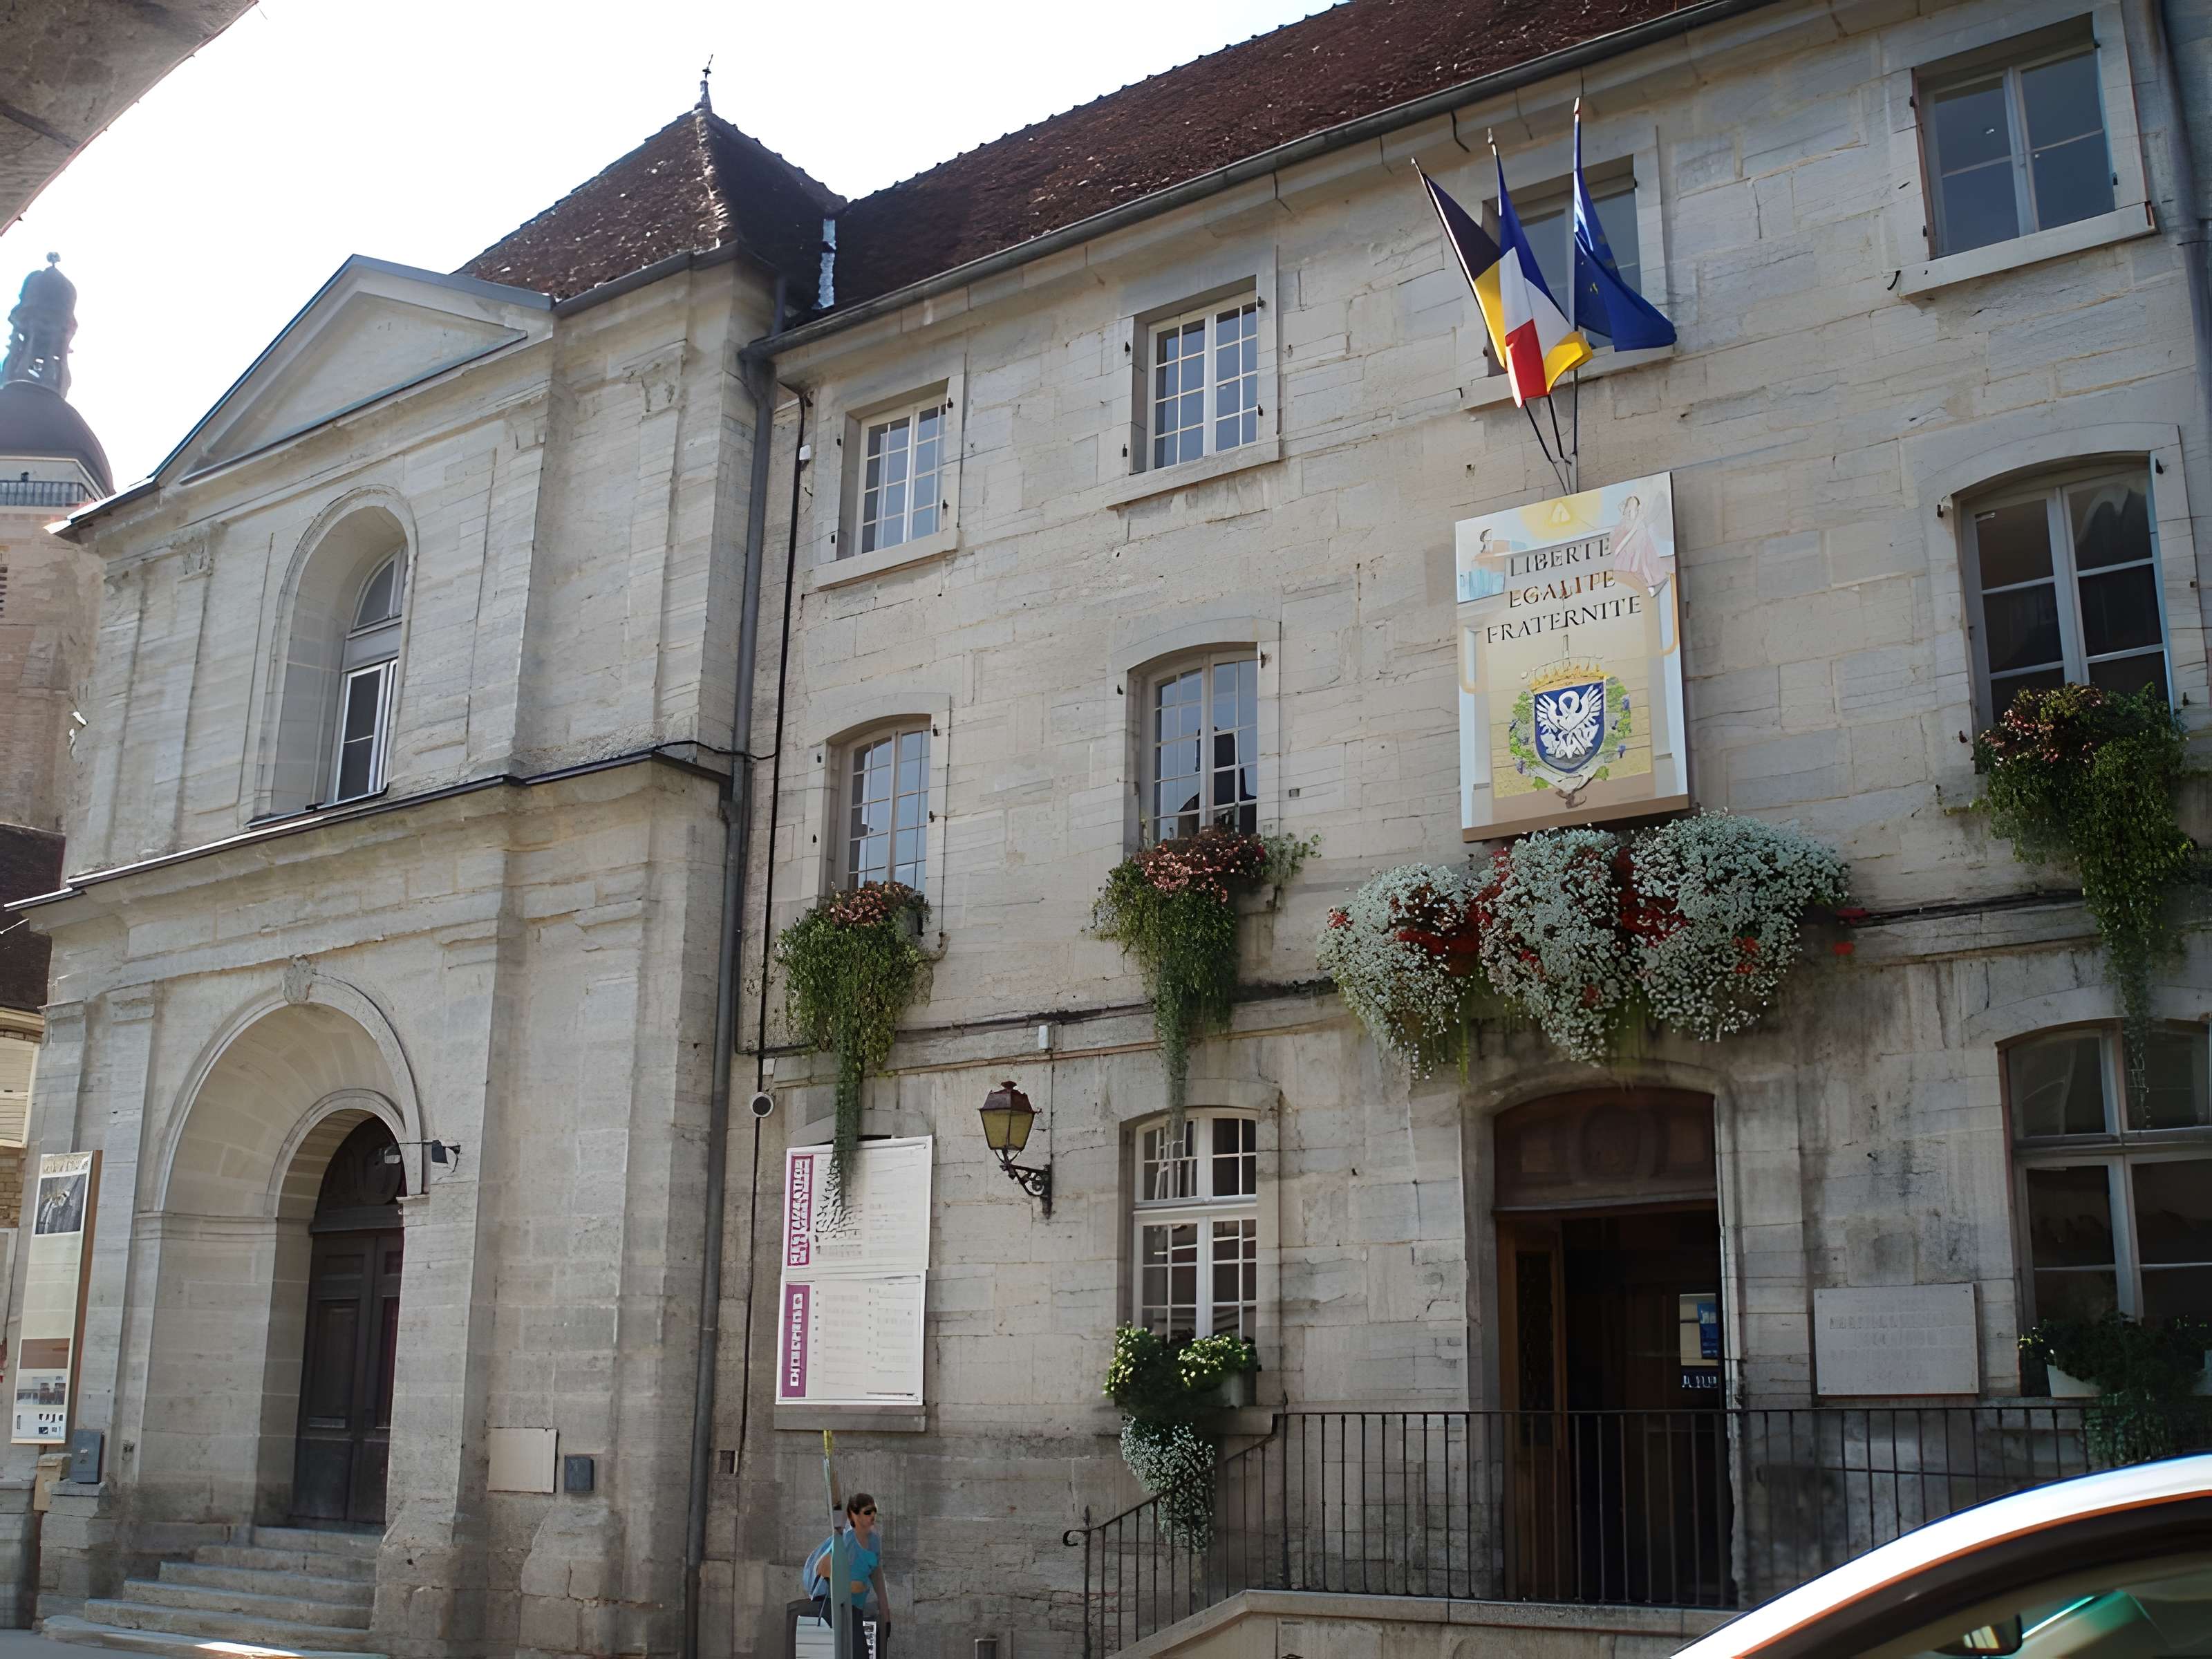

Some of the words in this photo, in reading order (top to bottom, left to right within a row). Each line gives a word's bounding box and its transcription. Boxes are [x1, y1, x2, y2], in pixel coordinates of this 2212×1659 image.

[1510, 536, 1612, 577] LIBERTE
[1509, 570, 1616, 608] EGALITE
[1487, 595, 1643, 644] FRATERNITE
